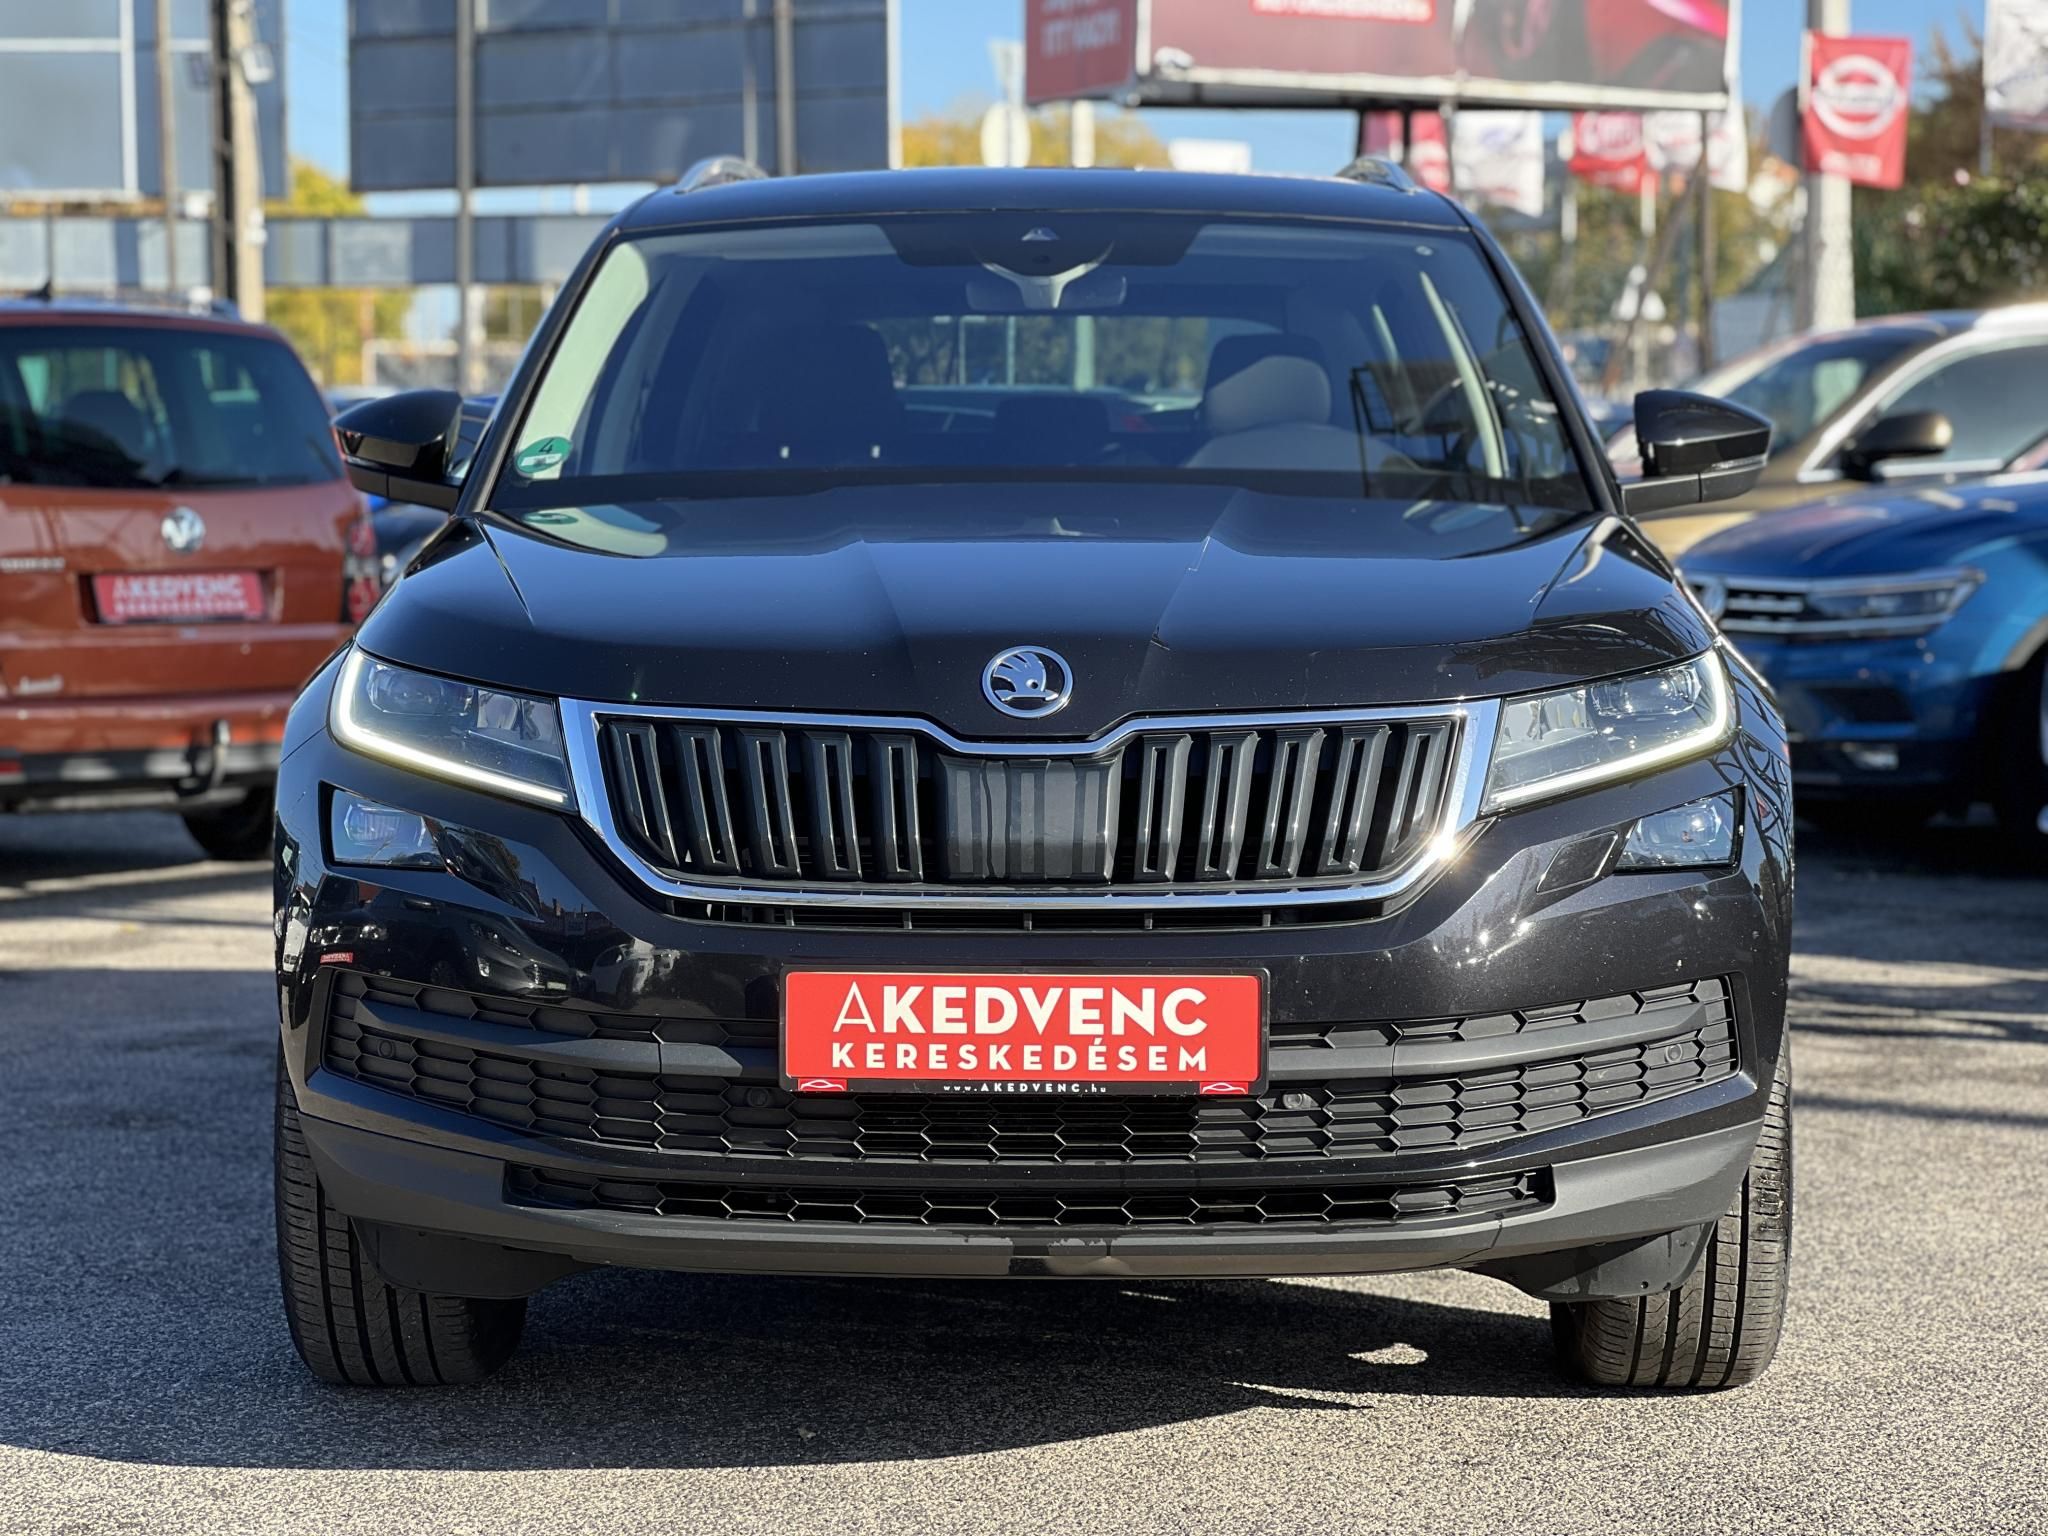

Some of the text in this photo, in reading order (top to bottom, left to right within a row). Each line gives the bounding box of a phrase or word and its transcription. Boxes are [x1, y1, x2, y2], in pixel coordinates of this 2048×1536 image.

[833, 981, 1208, 1036] AKEDVENC
[832, 1038, 1207, 1072] KERESKEDÉSEM
[943, 1082, 1107, 1093] www.AKEDVENC.hu
